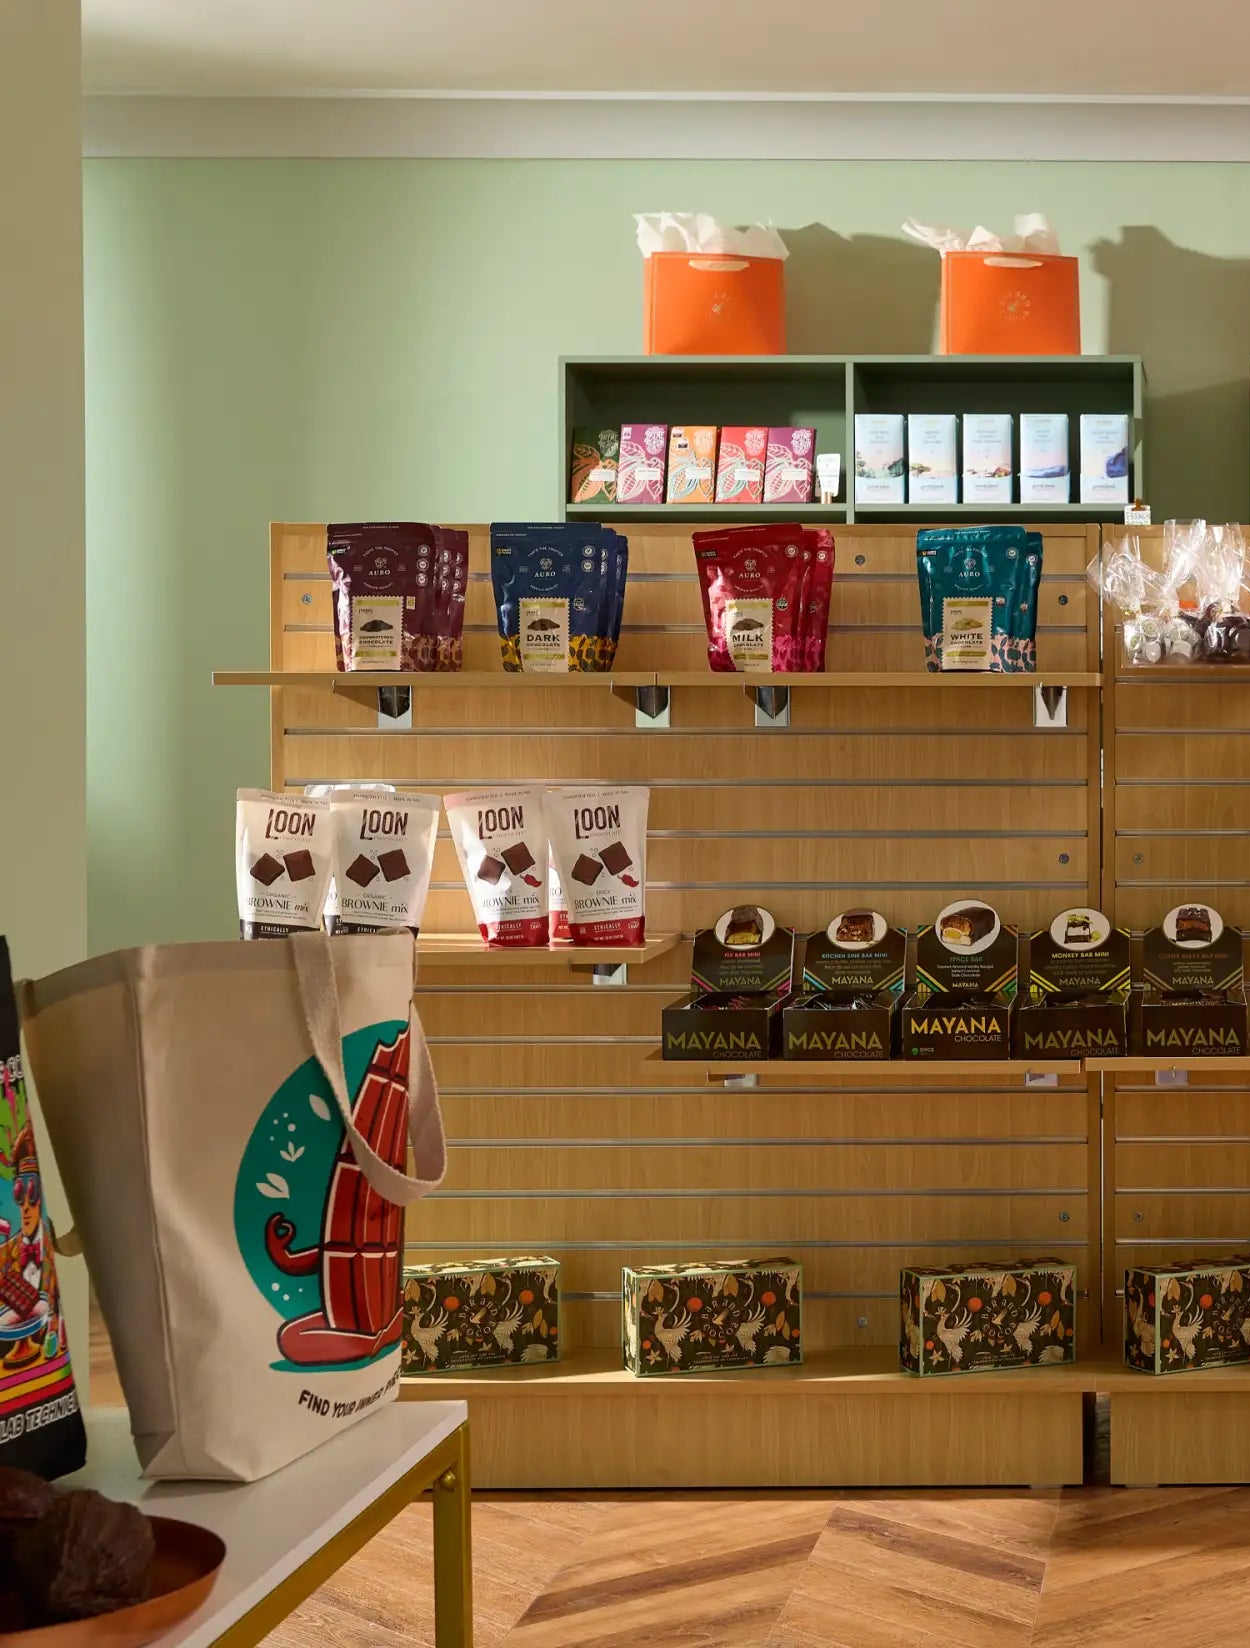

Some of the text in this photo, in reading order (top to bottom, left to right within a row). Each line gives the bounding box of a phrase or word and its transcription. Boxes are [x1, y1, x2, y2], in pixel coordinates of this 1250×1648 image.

[526, 634, 560, 642] DARK
[732, 634, 763, 642] MILK
[265, 808, 316, 840] LOON
[359, 808, 409, 841] LOON
[478, 805, 524, 840] LOON
[574, 804, 621, 840] LOON
[266, 891, 291, 900] ORGANIC
[362, 892, 387, 900] ORGANIC
[483, 893, 540, 909] ROWNIE mix
[574, 892, 637, 910] BROWNIE mix
[294, 901, 310, 913] mix
[341, 897, 409, 913] BROWNIE mix
[260, 925, 290, 933] ETHICALLY
[594, 922, 622, 931] ETHICALLY
[719, 976, 762, 985] MAYANA
[831, 975, 874, 985] MAYANA
[1059, 976, 1101, 987] MAYANA
[1172, 976, 1214, 985] MAYANA
[911, 1016, 1001, 1034] MAYANA
[667, 1031, 762, 1051] MAYANA
[789, 1031, 883, 1050] MAYANA
[954, 1033, 1001, 1043] CHOCOLATE
[1025, 1028, 1119, 1050] MAYANA
[1146, 1027, 1240, 1047] MAYANA
[712, 1051, 762, 1059] CHOCOLATE
[834, 1051, 883, 1059] CHOCOLATE
[1070, 1047, 1120, 1057] CHOCOLATE
[1192, 1046, 1241, 1055] CHOCOLATE
[298, 1389, 330, 1417] FIND
[332, 1400, 357, 1419] YOUR
[355, 1387, 384, 1413] INNER
